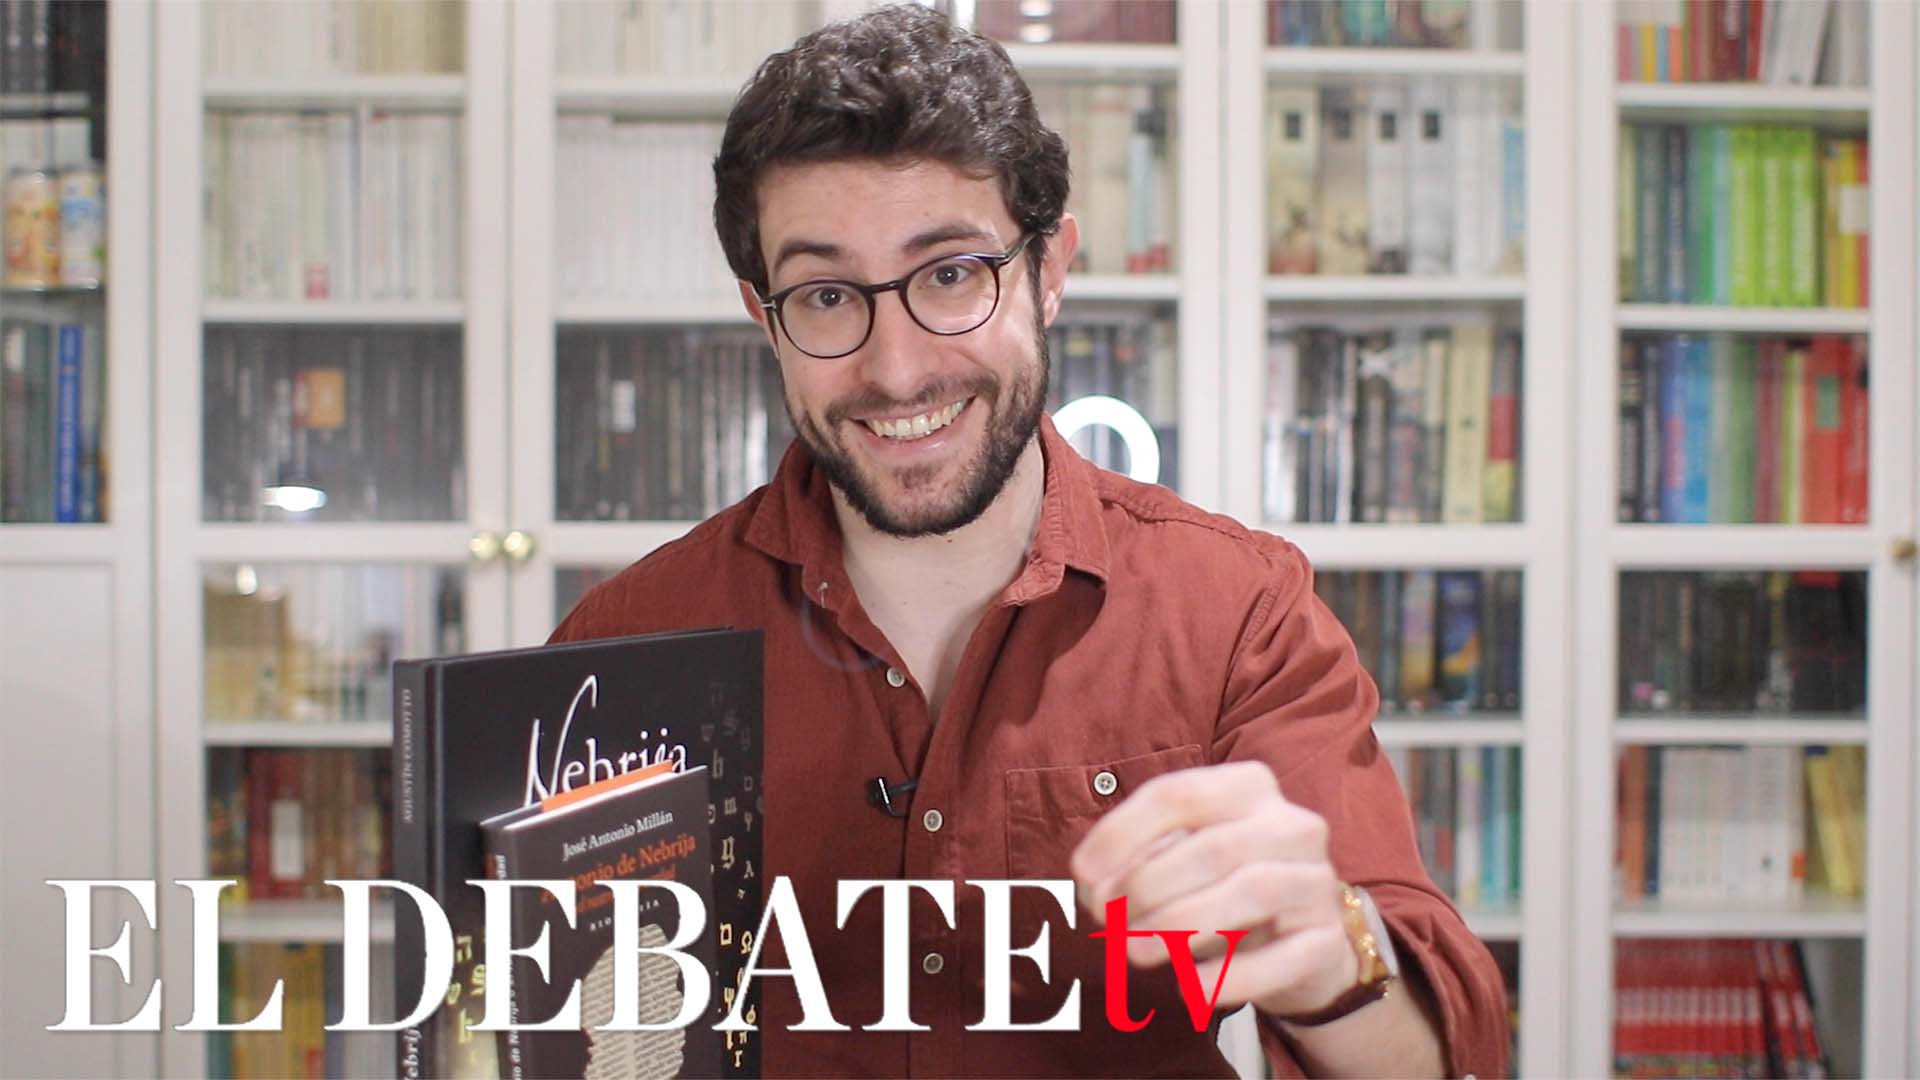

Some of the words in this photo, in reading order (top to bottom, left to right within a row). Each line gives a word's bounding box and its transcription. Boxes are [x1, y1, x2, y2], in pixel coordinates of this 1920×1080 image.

[562, 836, 587, 861] José
[588, 824, 636, 849] Antonio
[637, 810, 673, 836] Millán
[616, 852, 638, 877] de
[640, 833, 697, 868] Nebrija
